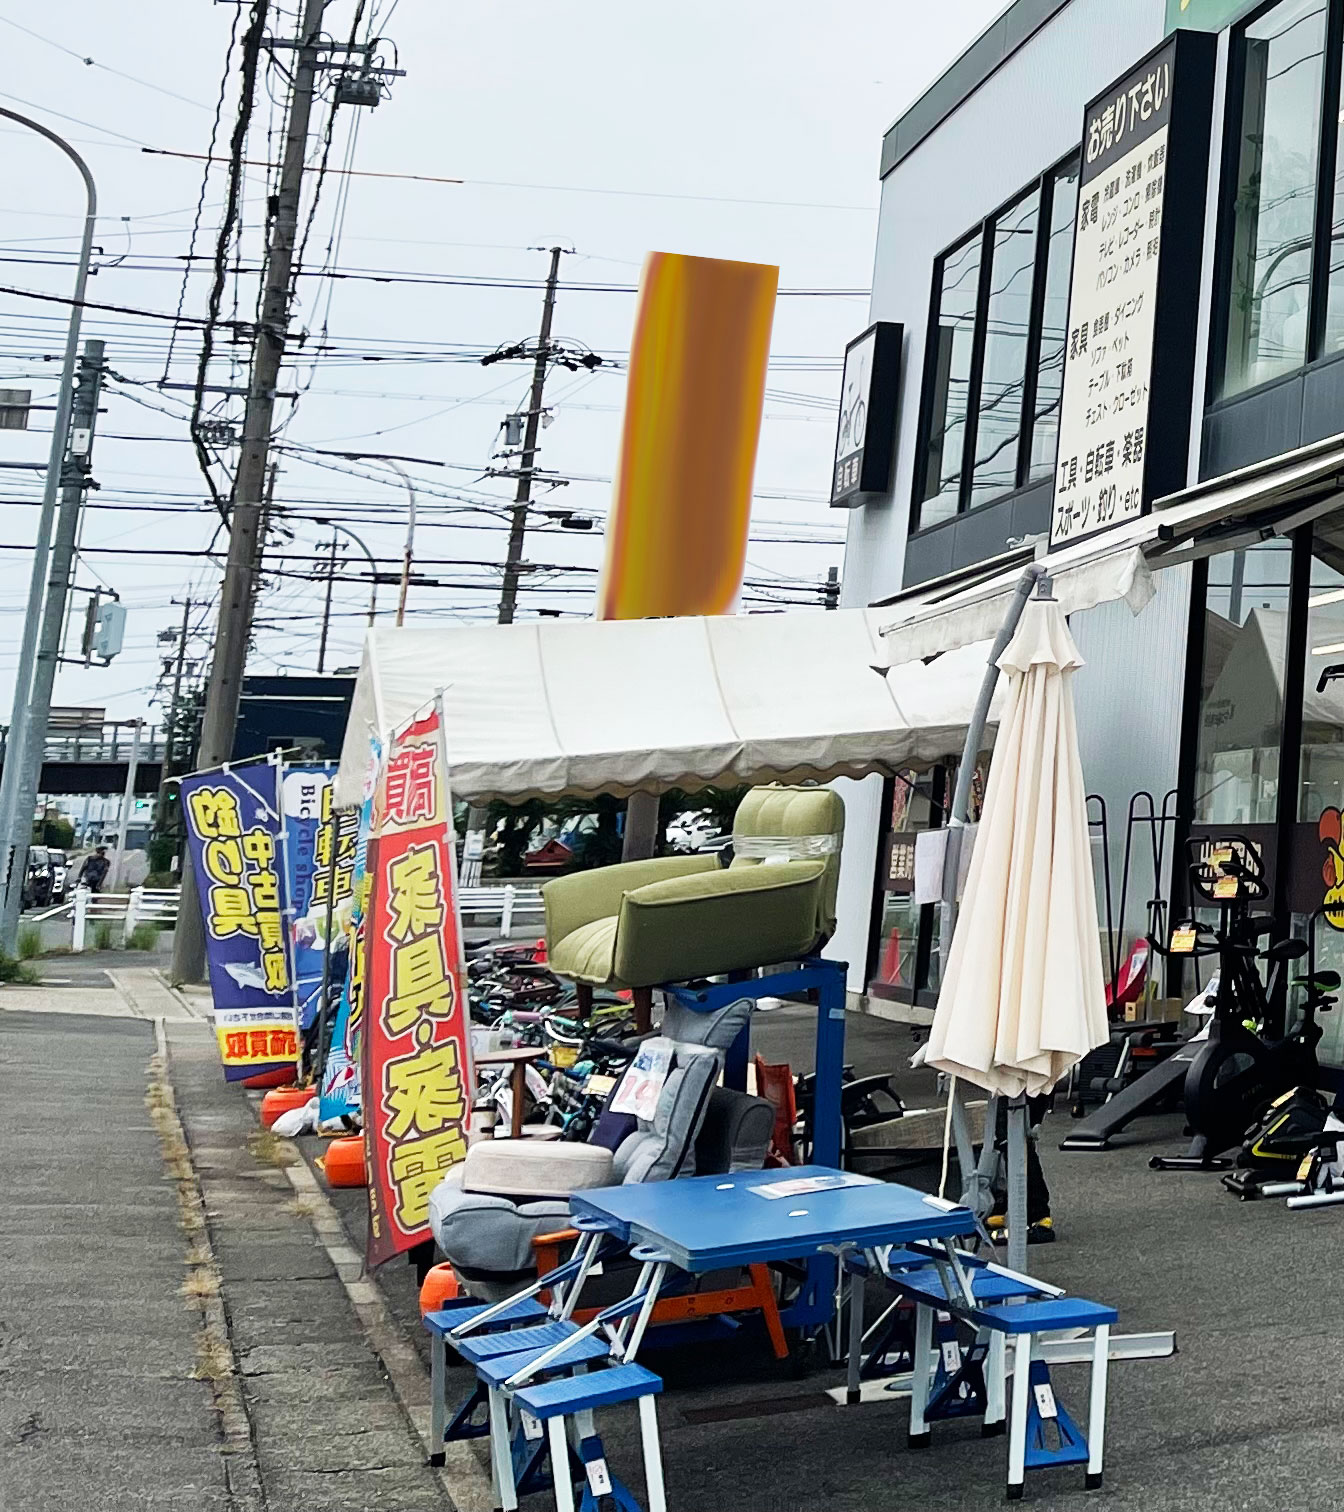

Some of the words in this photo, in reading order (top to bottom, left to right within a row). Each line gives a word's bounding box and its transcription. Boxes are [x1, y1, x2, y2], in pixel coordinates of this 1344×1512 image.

[1087, 63, 1169, 163] お売り下さい
